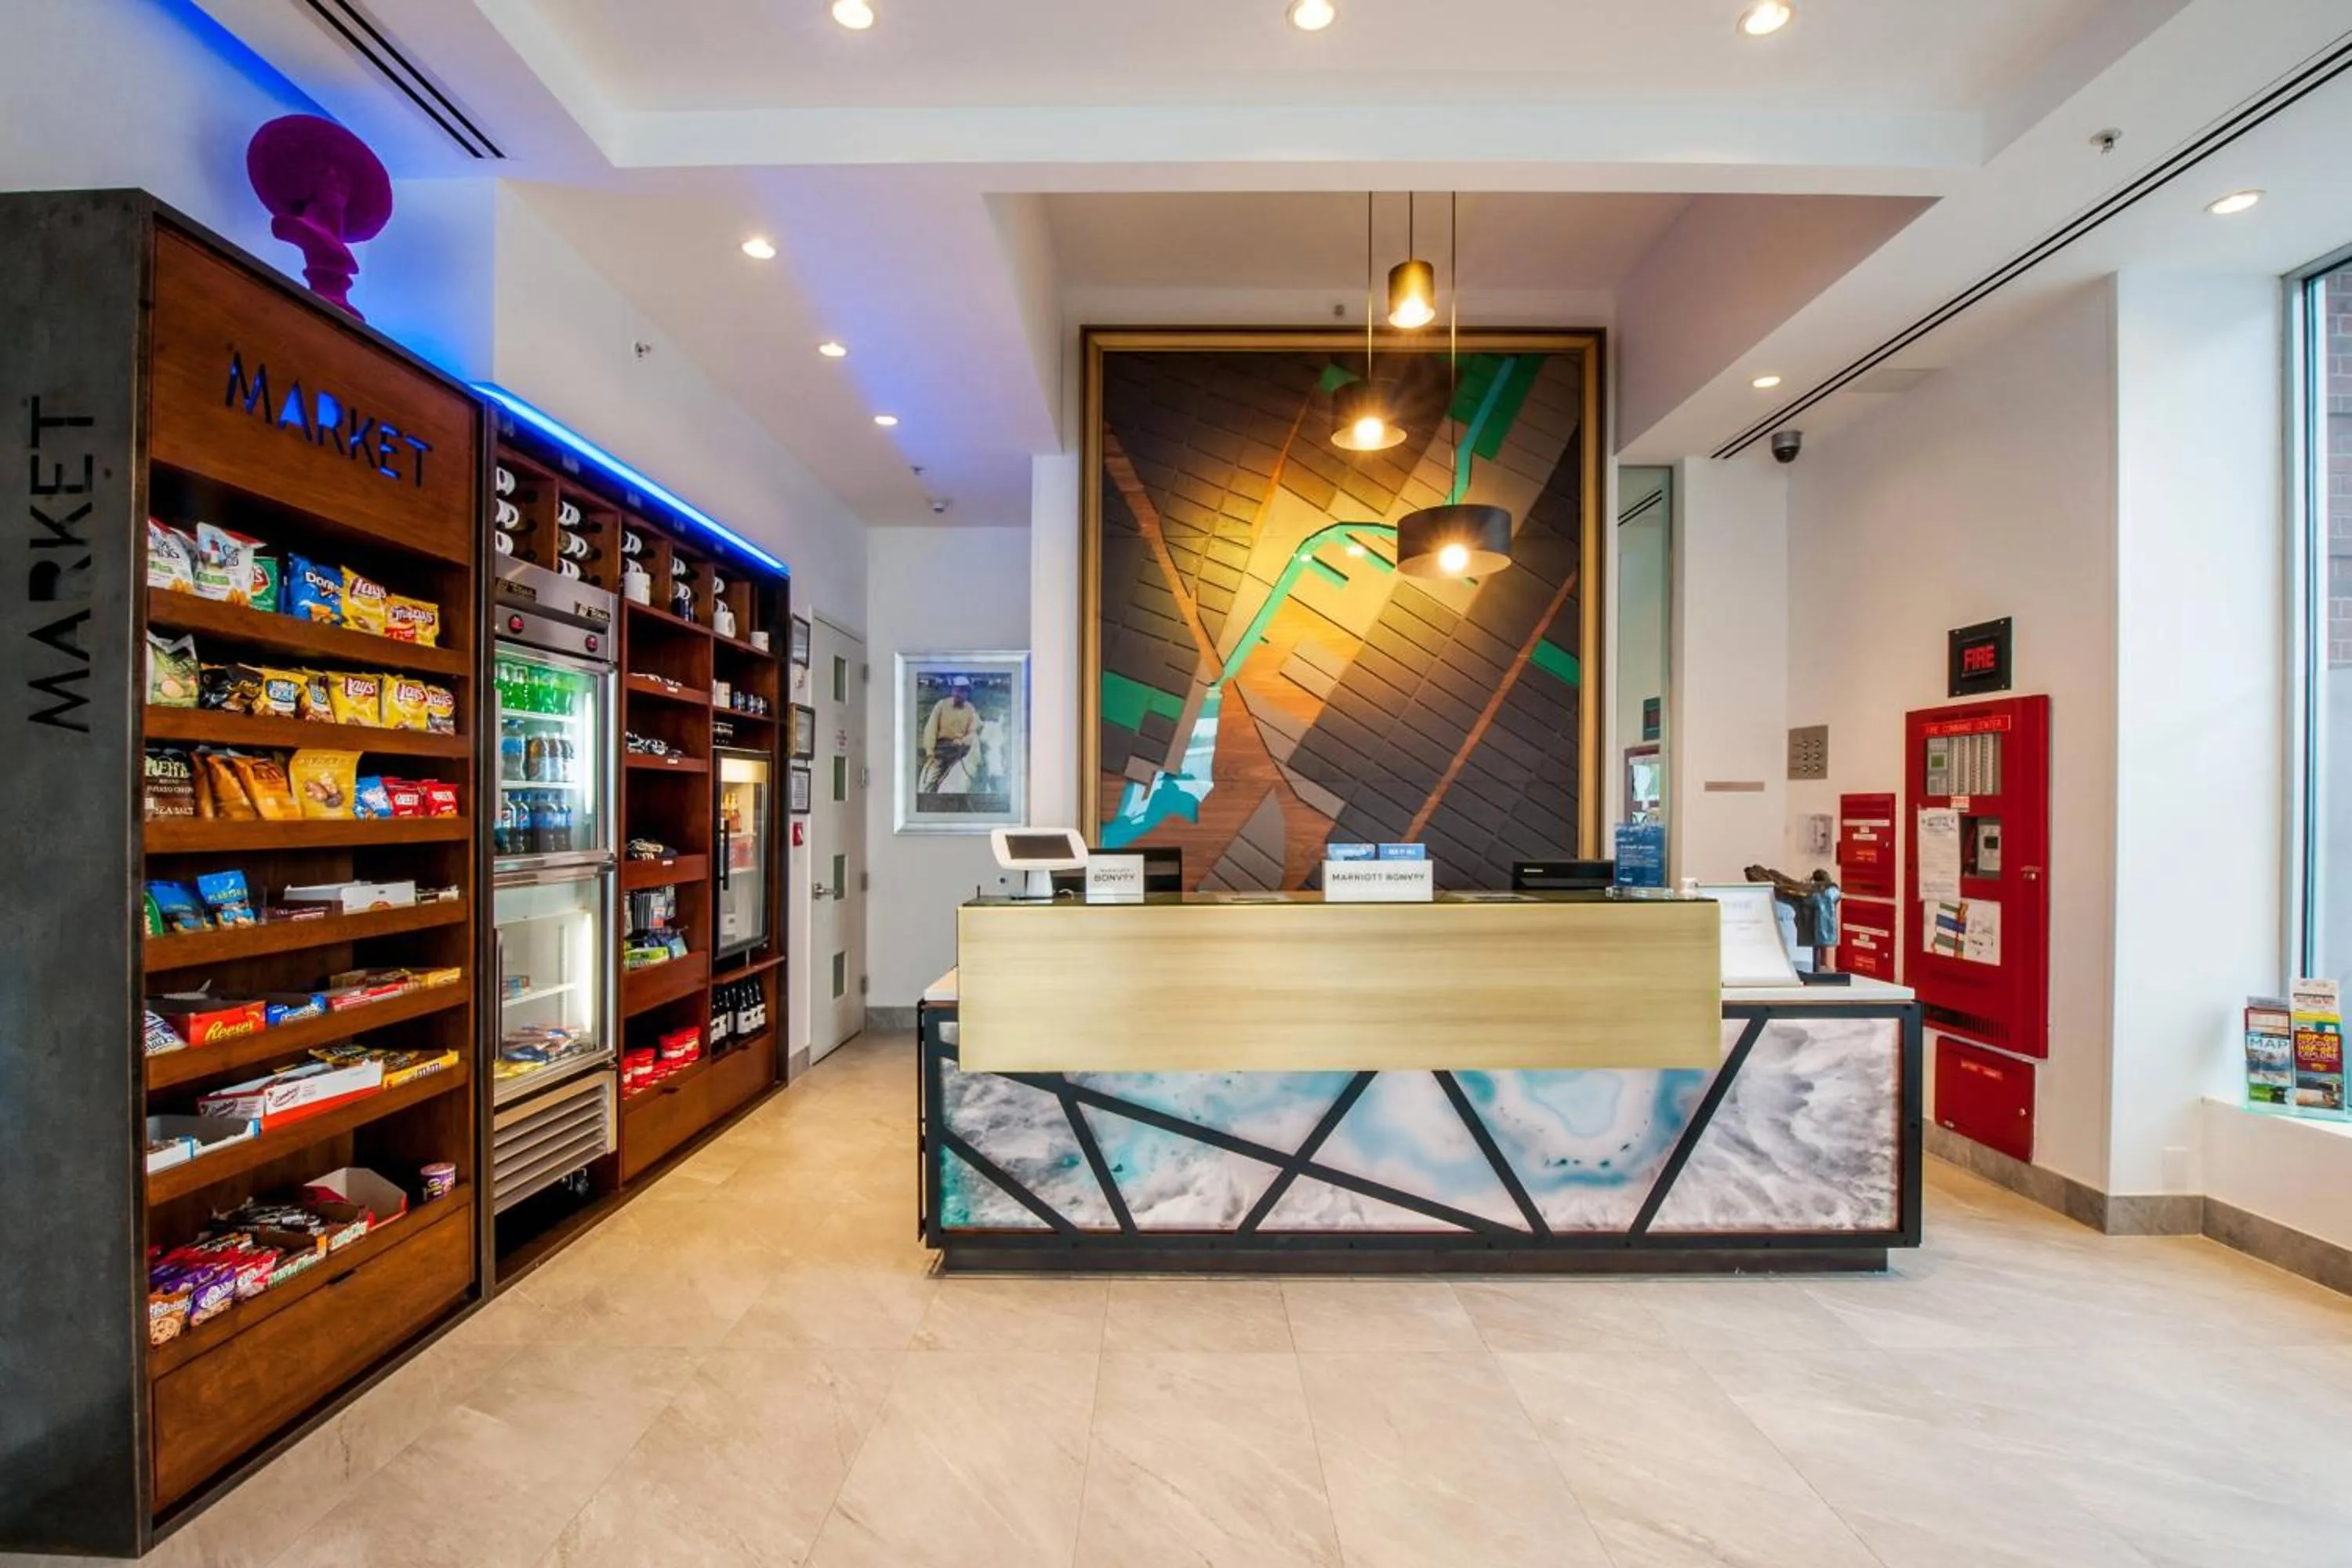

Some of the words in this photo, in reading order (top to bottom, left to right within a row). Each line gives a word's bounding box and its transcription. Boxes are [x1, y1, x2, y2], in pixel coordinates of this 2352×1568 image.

[225, 350, 433, 488] MARKET
[27, 395, 94, 733] MARKET
[1964, 644, 1995, 672] FIRE
[1332, 873, 1383, 882] MARRIOTT
[2249, 1036, 2288, 1050] MAP
